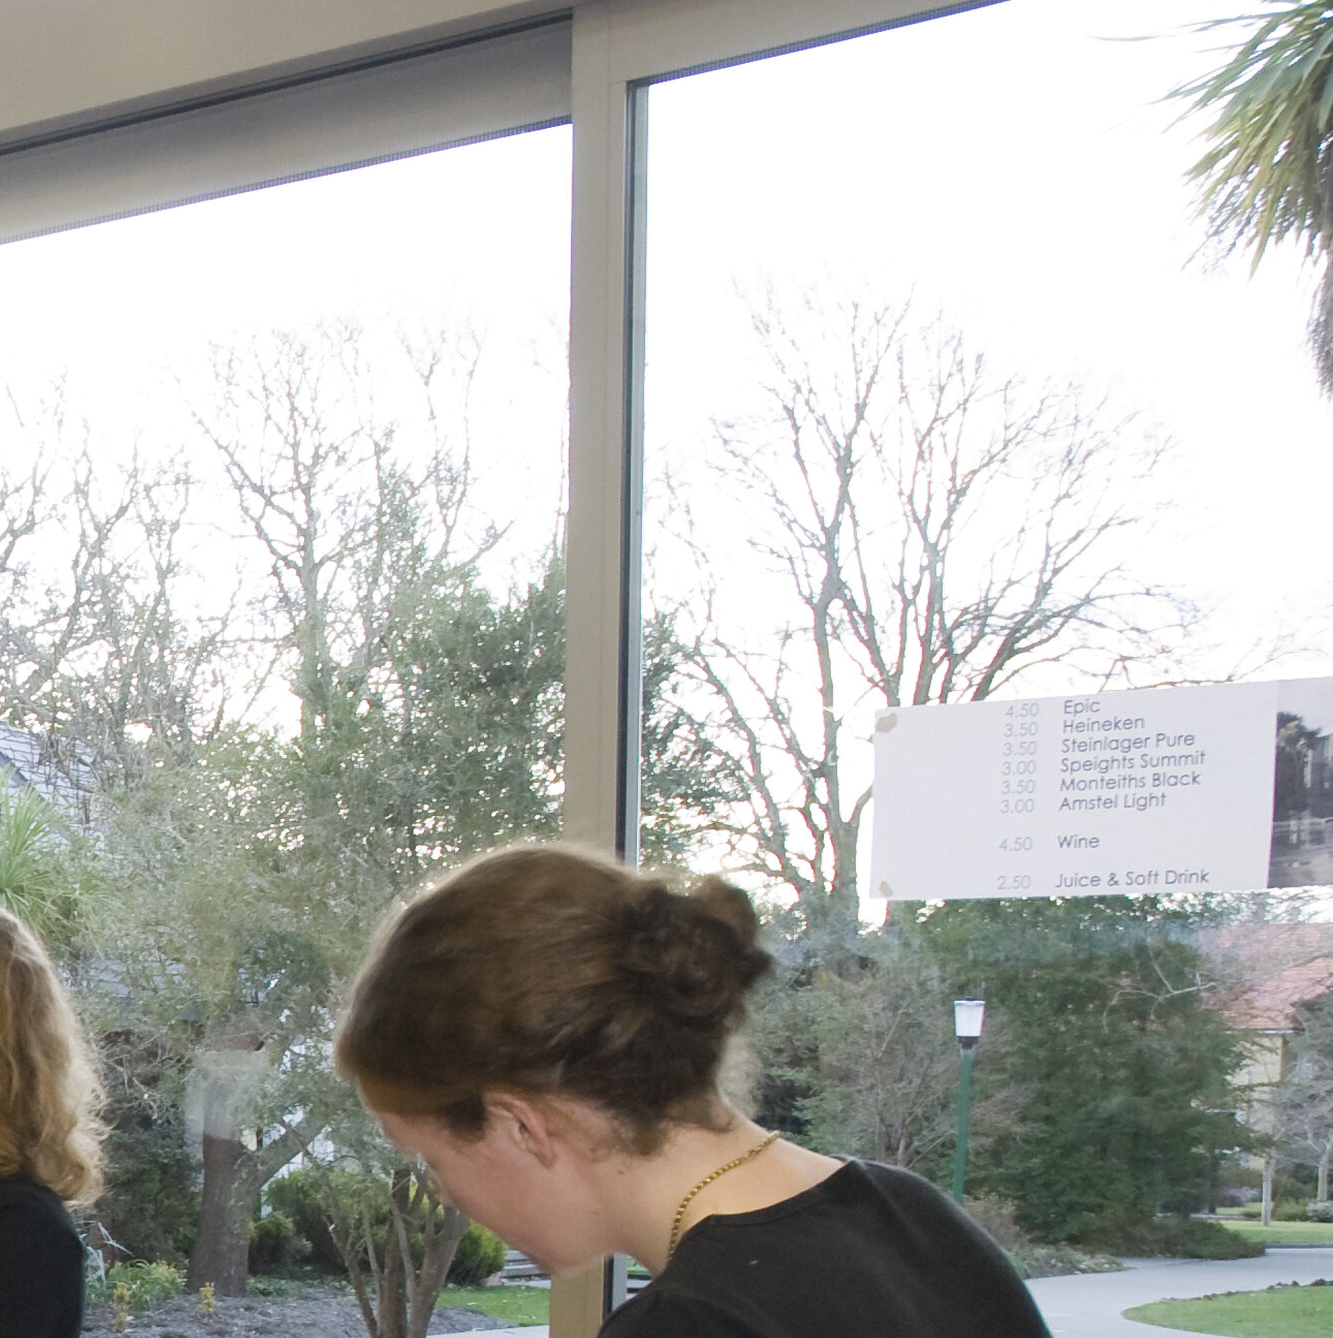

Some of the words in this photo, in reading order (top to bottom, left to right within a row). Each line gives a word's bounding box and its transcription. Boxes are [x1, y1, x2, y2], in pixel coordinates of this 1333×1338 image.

[1005, 702, 1039, 718] 4.50
[1063, 699, 1101, 717] Epic
[1003, 721, 1038, 737] 3.50
[1062, 716, 1145, 734] Heineken
[1002, 740, 1037, 757] 3.50
[1061, 736, 1150, 753] Steinlager
[1155, 732, 1195, 748] Pure
[1001, 760, 1036, 776] 3.00
[1060, 754, 1135, 775] Speights
[1139, 750, 1206, 769] Summit
[1000, 779, 1036, 795] 3.50
[1059, 774, 1146, 792] Monteiths
[1151, 771, 1201, 788] Black
[999, 798, 1035, 814] 3.00
[1058, 794, 1118, 811] Amstel
[1123, 792, 1166, 811] Light
[998, 836, 1033, 852] 4.50
[1057, 834, 1100, 849] Wine
[997, 874, 1032, 890] 2.50
[1055, 872, 1101, 888] Juice
[1107, 872, 1119, 887] &
[1124, 870, 1159, 886] Soft
[1164, 868, 1210, 885] Drink
